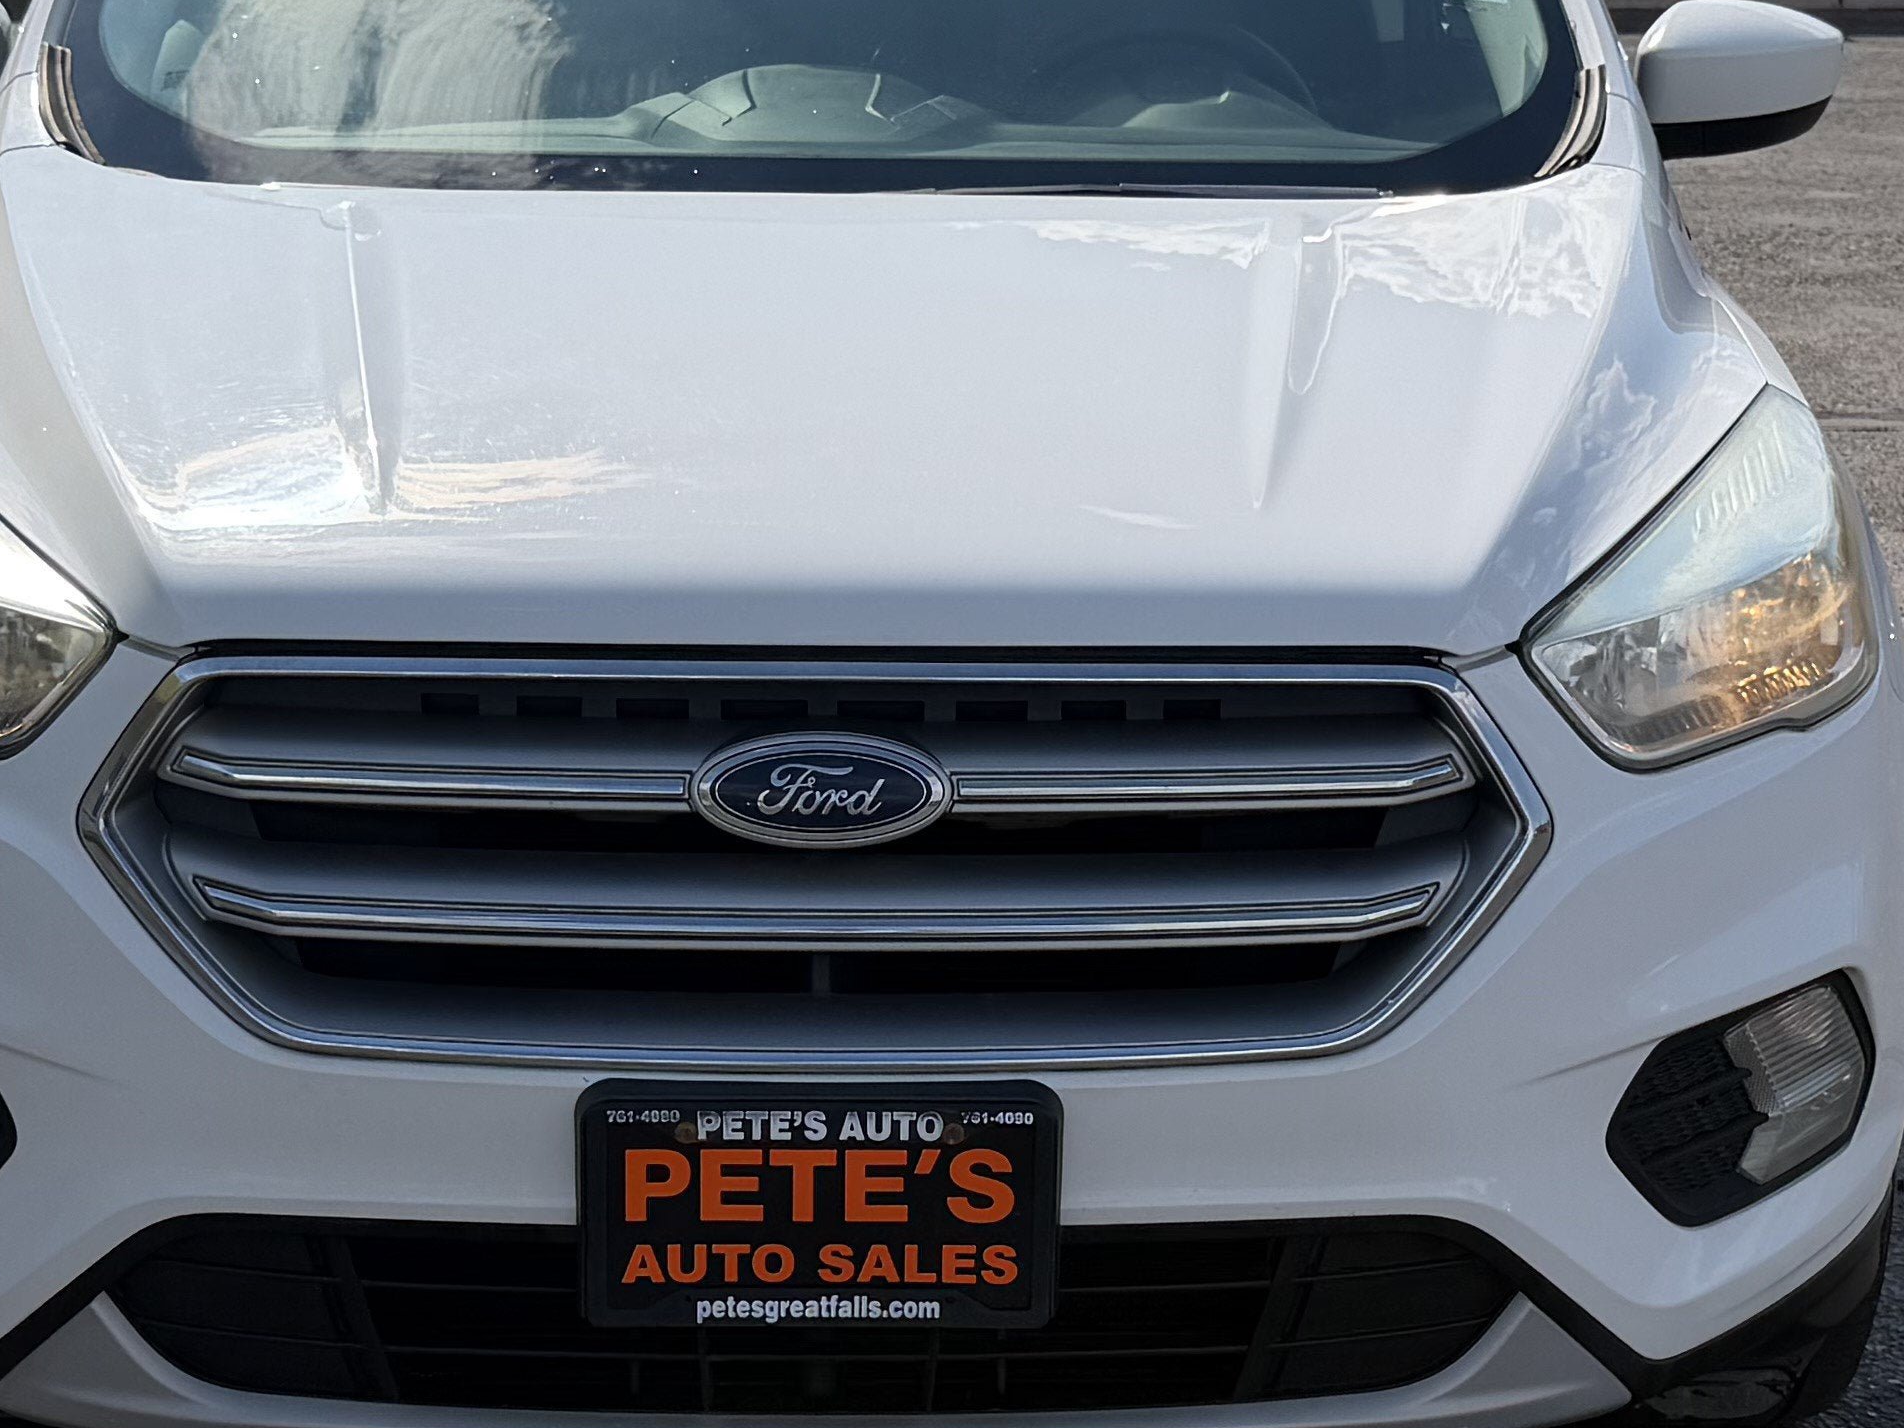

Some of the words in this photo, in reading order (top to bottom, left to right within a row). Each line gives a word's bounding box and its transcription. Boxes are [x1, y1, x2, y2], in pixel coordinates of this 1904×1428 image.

[756, 763, 886, 816] Ford
[696, 1110, 828, 1141] PETE'S
[838, 1111, 944, 1142] AUTO
[624, 1149, 1016, 1224] PETE'S
[621, 1244, 795, 1284] AUTO
[817, 1244, 1019, 1285] SALES
[696, 1294, 940, 1324] petesgreatfalls.com
